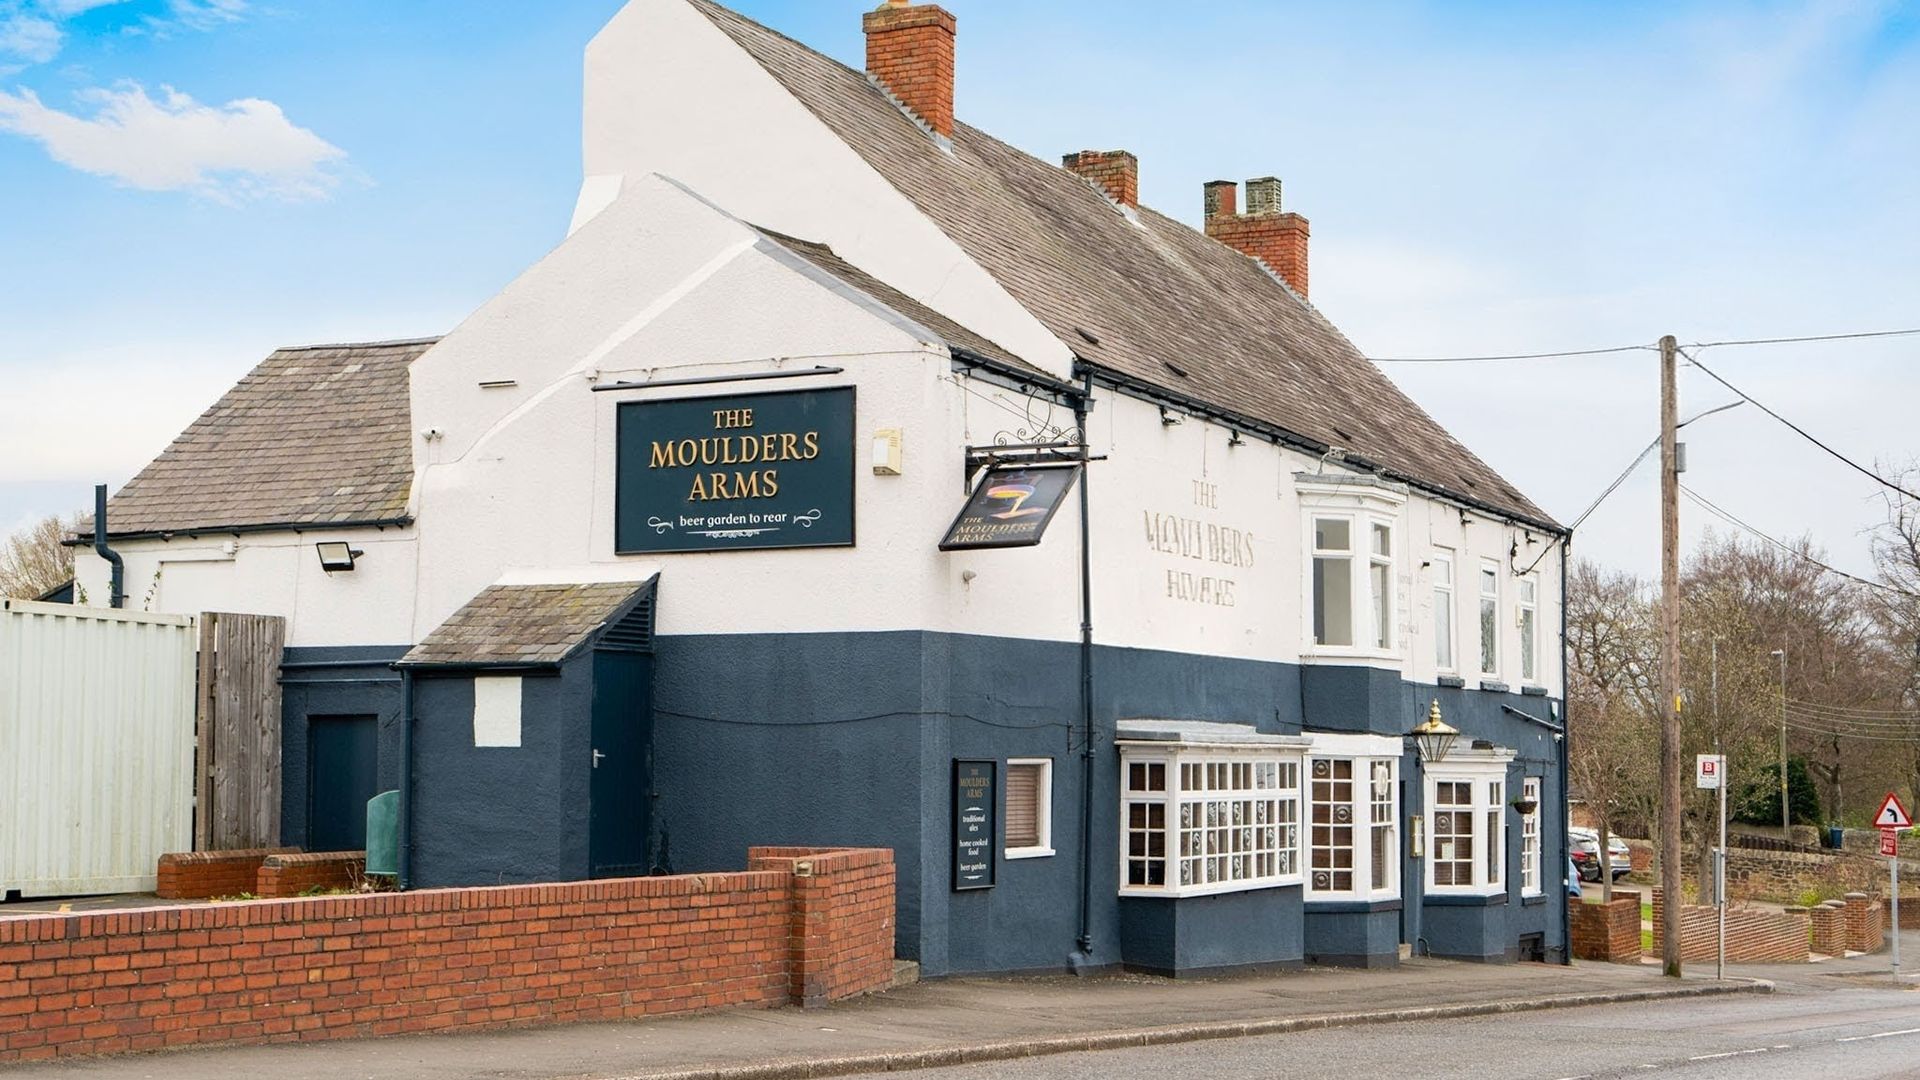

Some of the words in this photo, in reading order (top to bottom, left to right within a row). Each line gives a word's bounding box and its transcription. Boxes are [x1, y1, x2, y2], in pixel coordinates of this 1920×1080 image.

[713, 409, 753, 429] THE
[648, 431, 819, 469] MOULDERS
[687, 470, 779, 501] ARMS
[1192, 479, 1218, 510] THE
[679, 514, 704, 527] beer
[707, 513, 746, 528] garden
[749, 513, 761, 524] to
[763, 513, 788, 524] rear
[949, 534, 993, 543] ARMS
